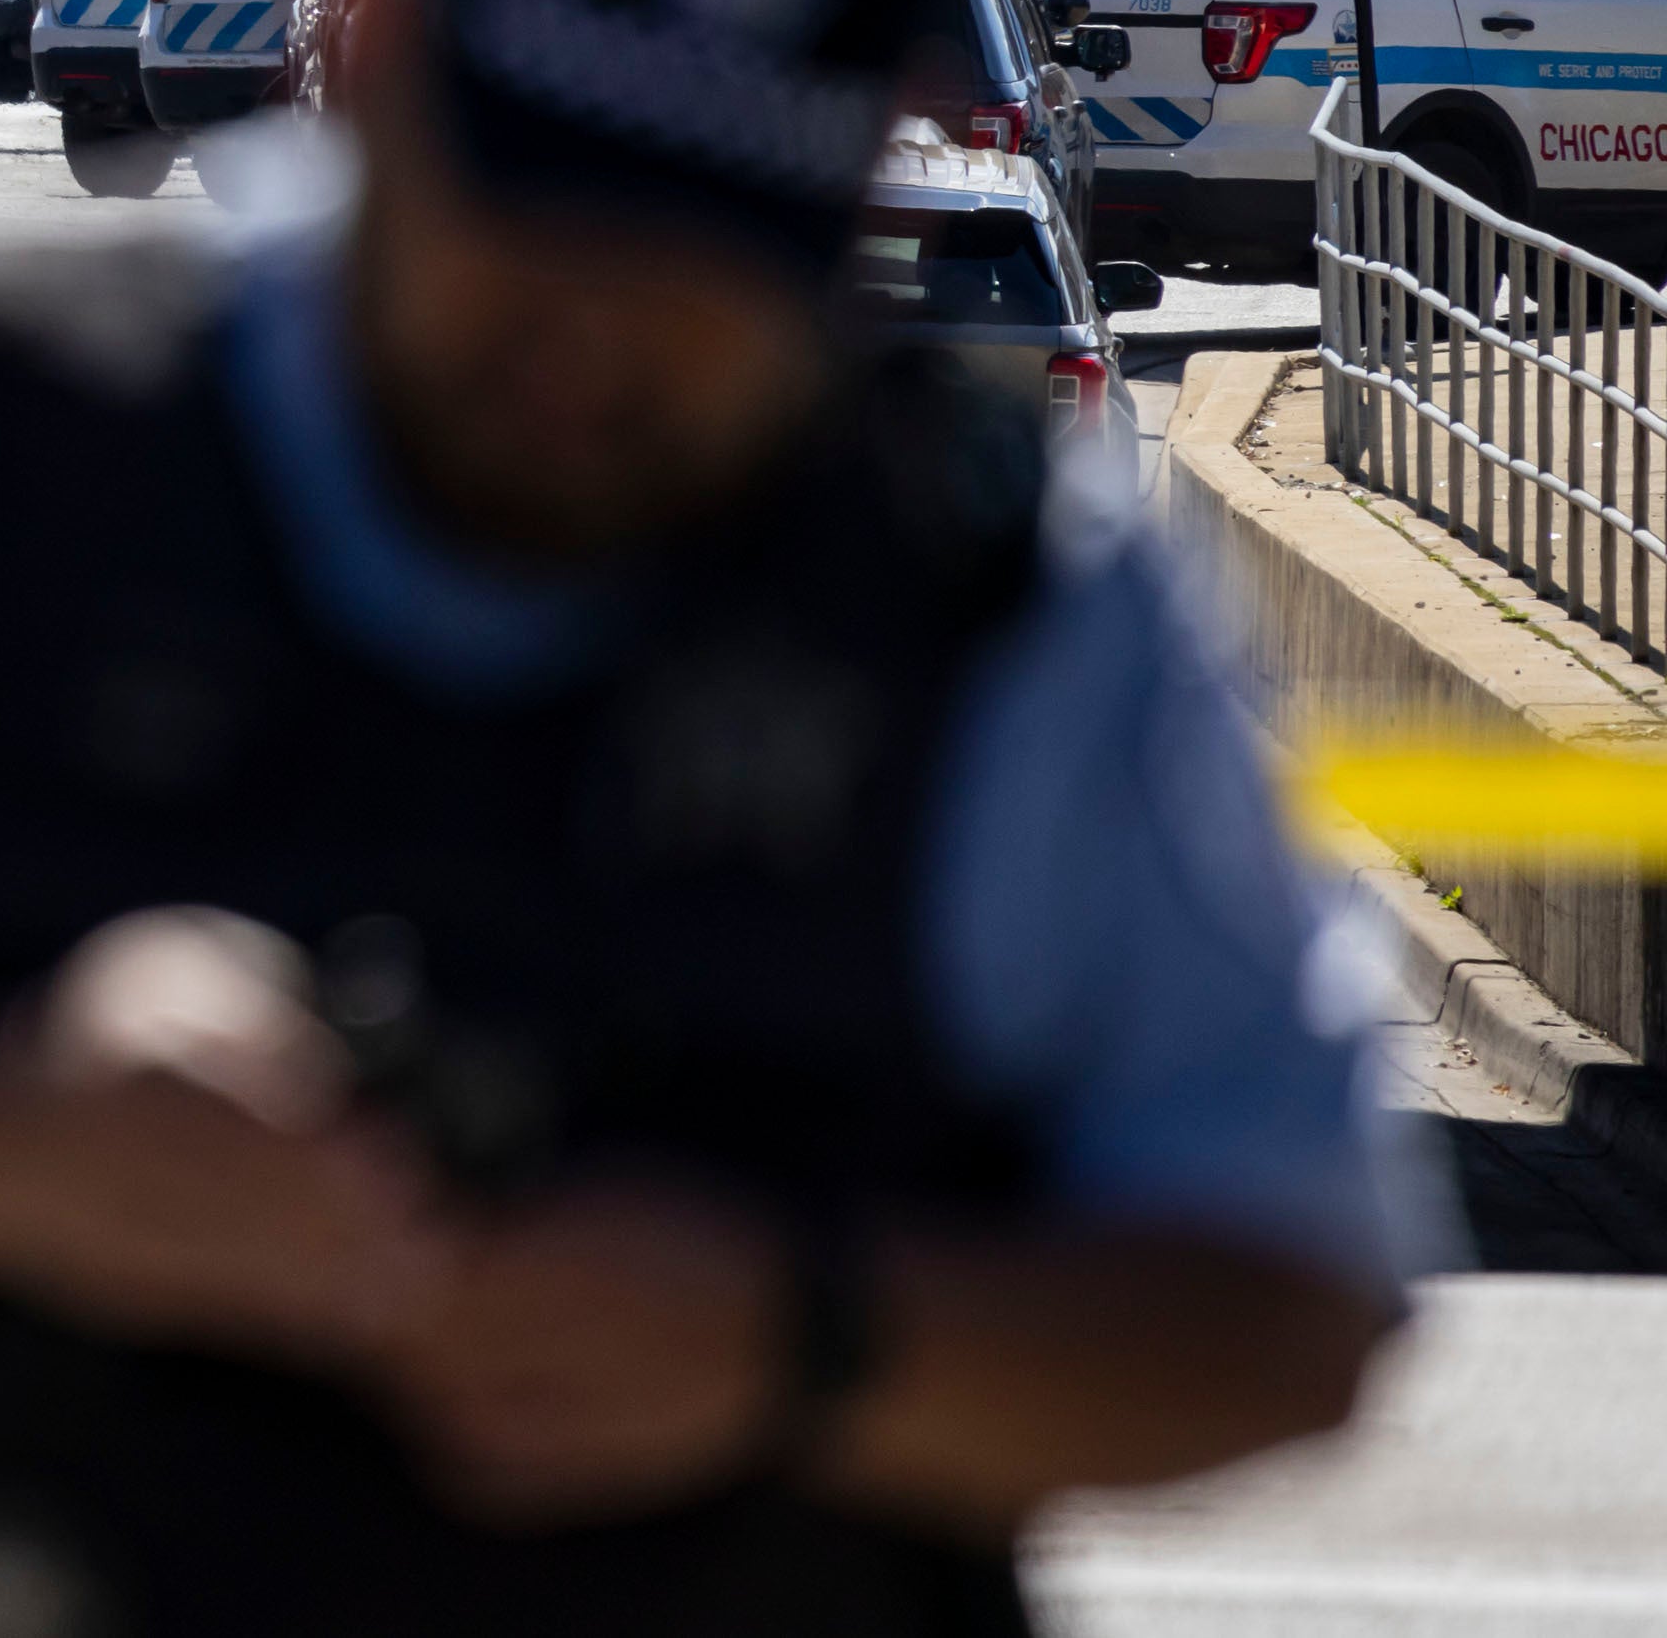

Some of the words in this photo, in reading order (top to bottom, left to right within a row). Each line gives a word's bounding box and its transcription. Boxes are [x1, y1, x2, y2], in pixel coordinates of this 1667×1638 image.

[1539, 64, 1554, 77] WE
[1558, 64, 1591, 78] SERVE
[1595, 65, 1615, 79] AND
[1619, 65, 1663, 80] PROTECT
